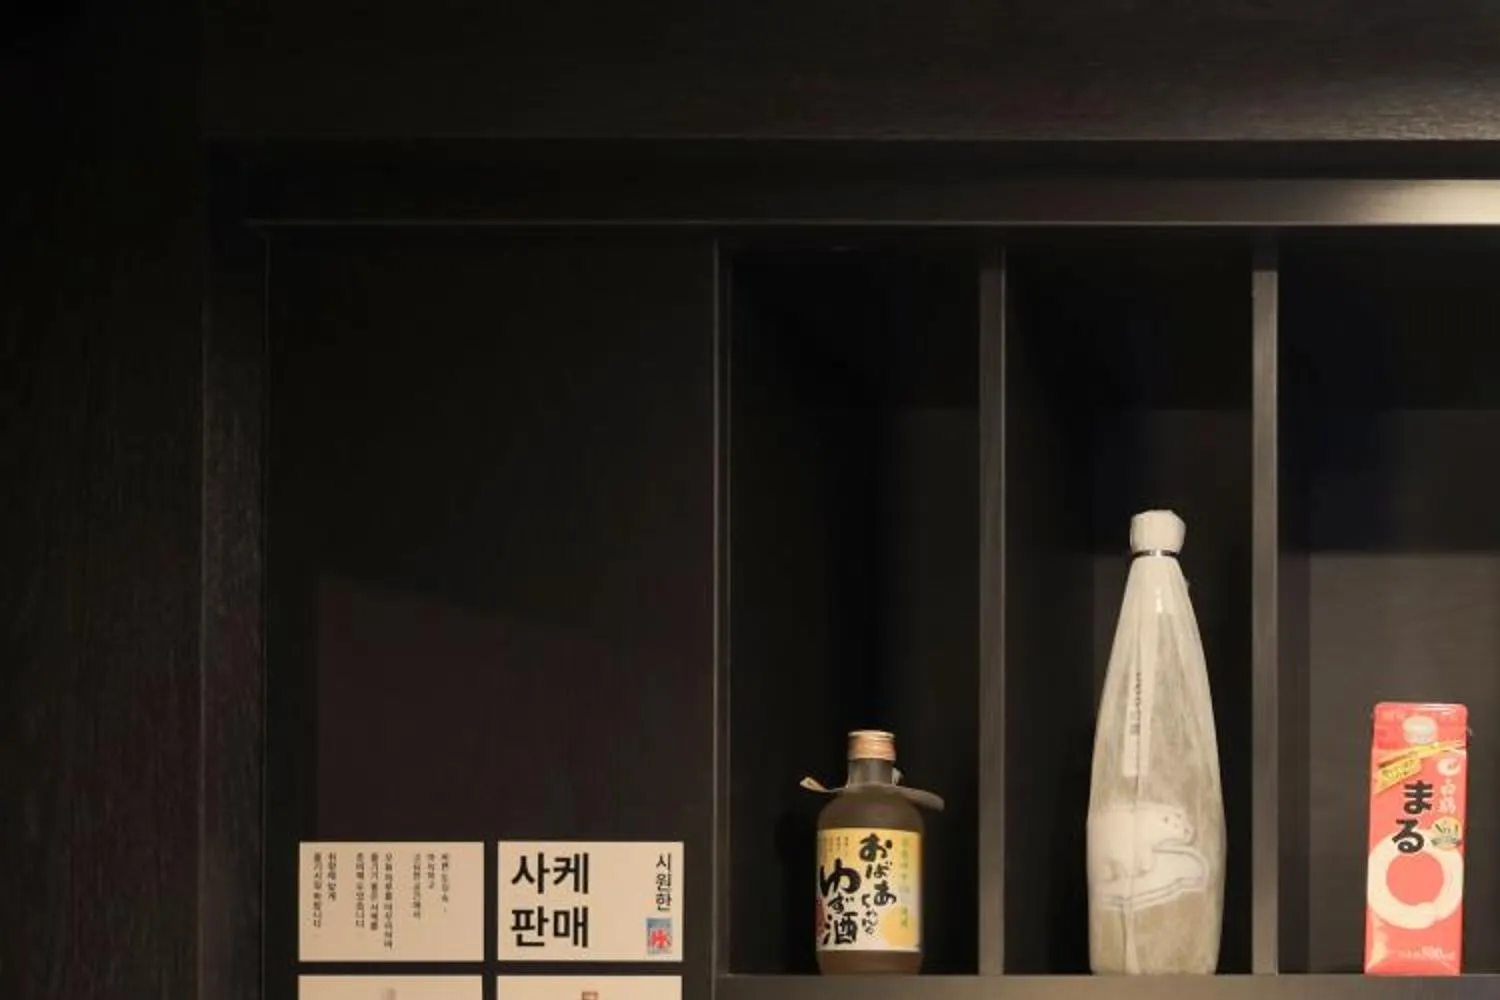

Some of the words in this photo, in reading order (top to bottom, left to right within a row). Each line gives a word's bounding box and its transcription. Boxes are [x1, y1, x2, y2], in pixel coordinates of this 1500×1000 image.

[1391, 779, 1433, 854] まる
[510, 852, 590, 894] 사케
[655, 852, 673, 912] 시원한
[820, 857, 862, 946] ゆず酒
[510, 906, 590, 949] 판매
